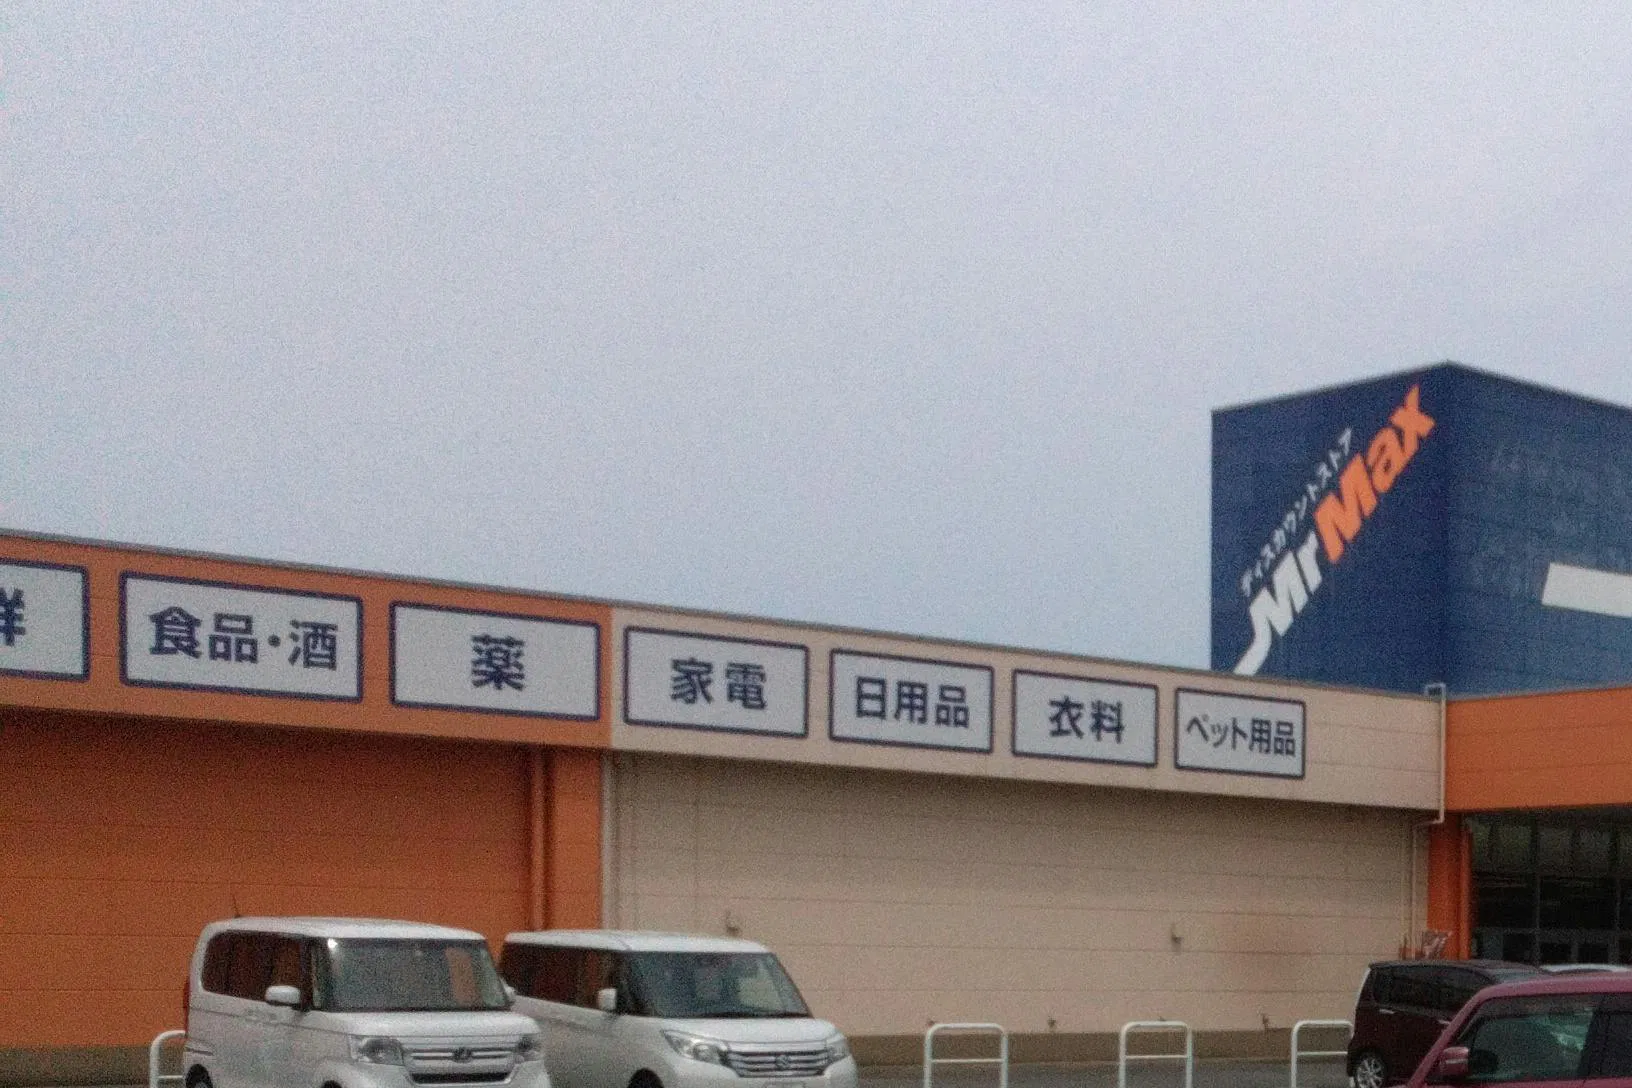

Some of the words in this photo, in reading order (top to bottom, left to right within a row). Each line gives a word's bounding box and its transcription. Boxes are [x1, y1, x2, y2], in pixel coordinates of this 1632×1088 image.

[1233, 384, 1436, 676] MrMax
[149, 605, 339, 671] 食品・酒
[470, 633, 526, 692] 薬
[670, 656, 768, 711] 家電
[855, 675, 970, 729] 日用品
[1048, 695, 1126, 744] 衣料
[1186, 713, 1296, 757] ペット用品
